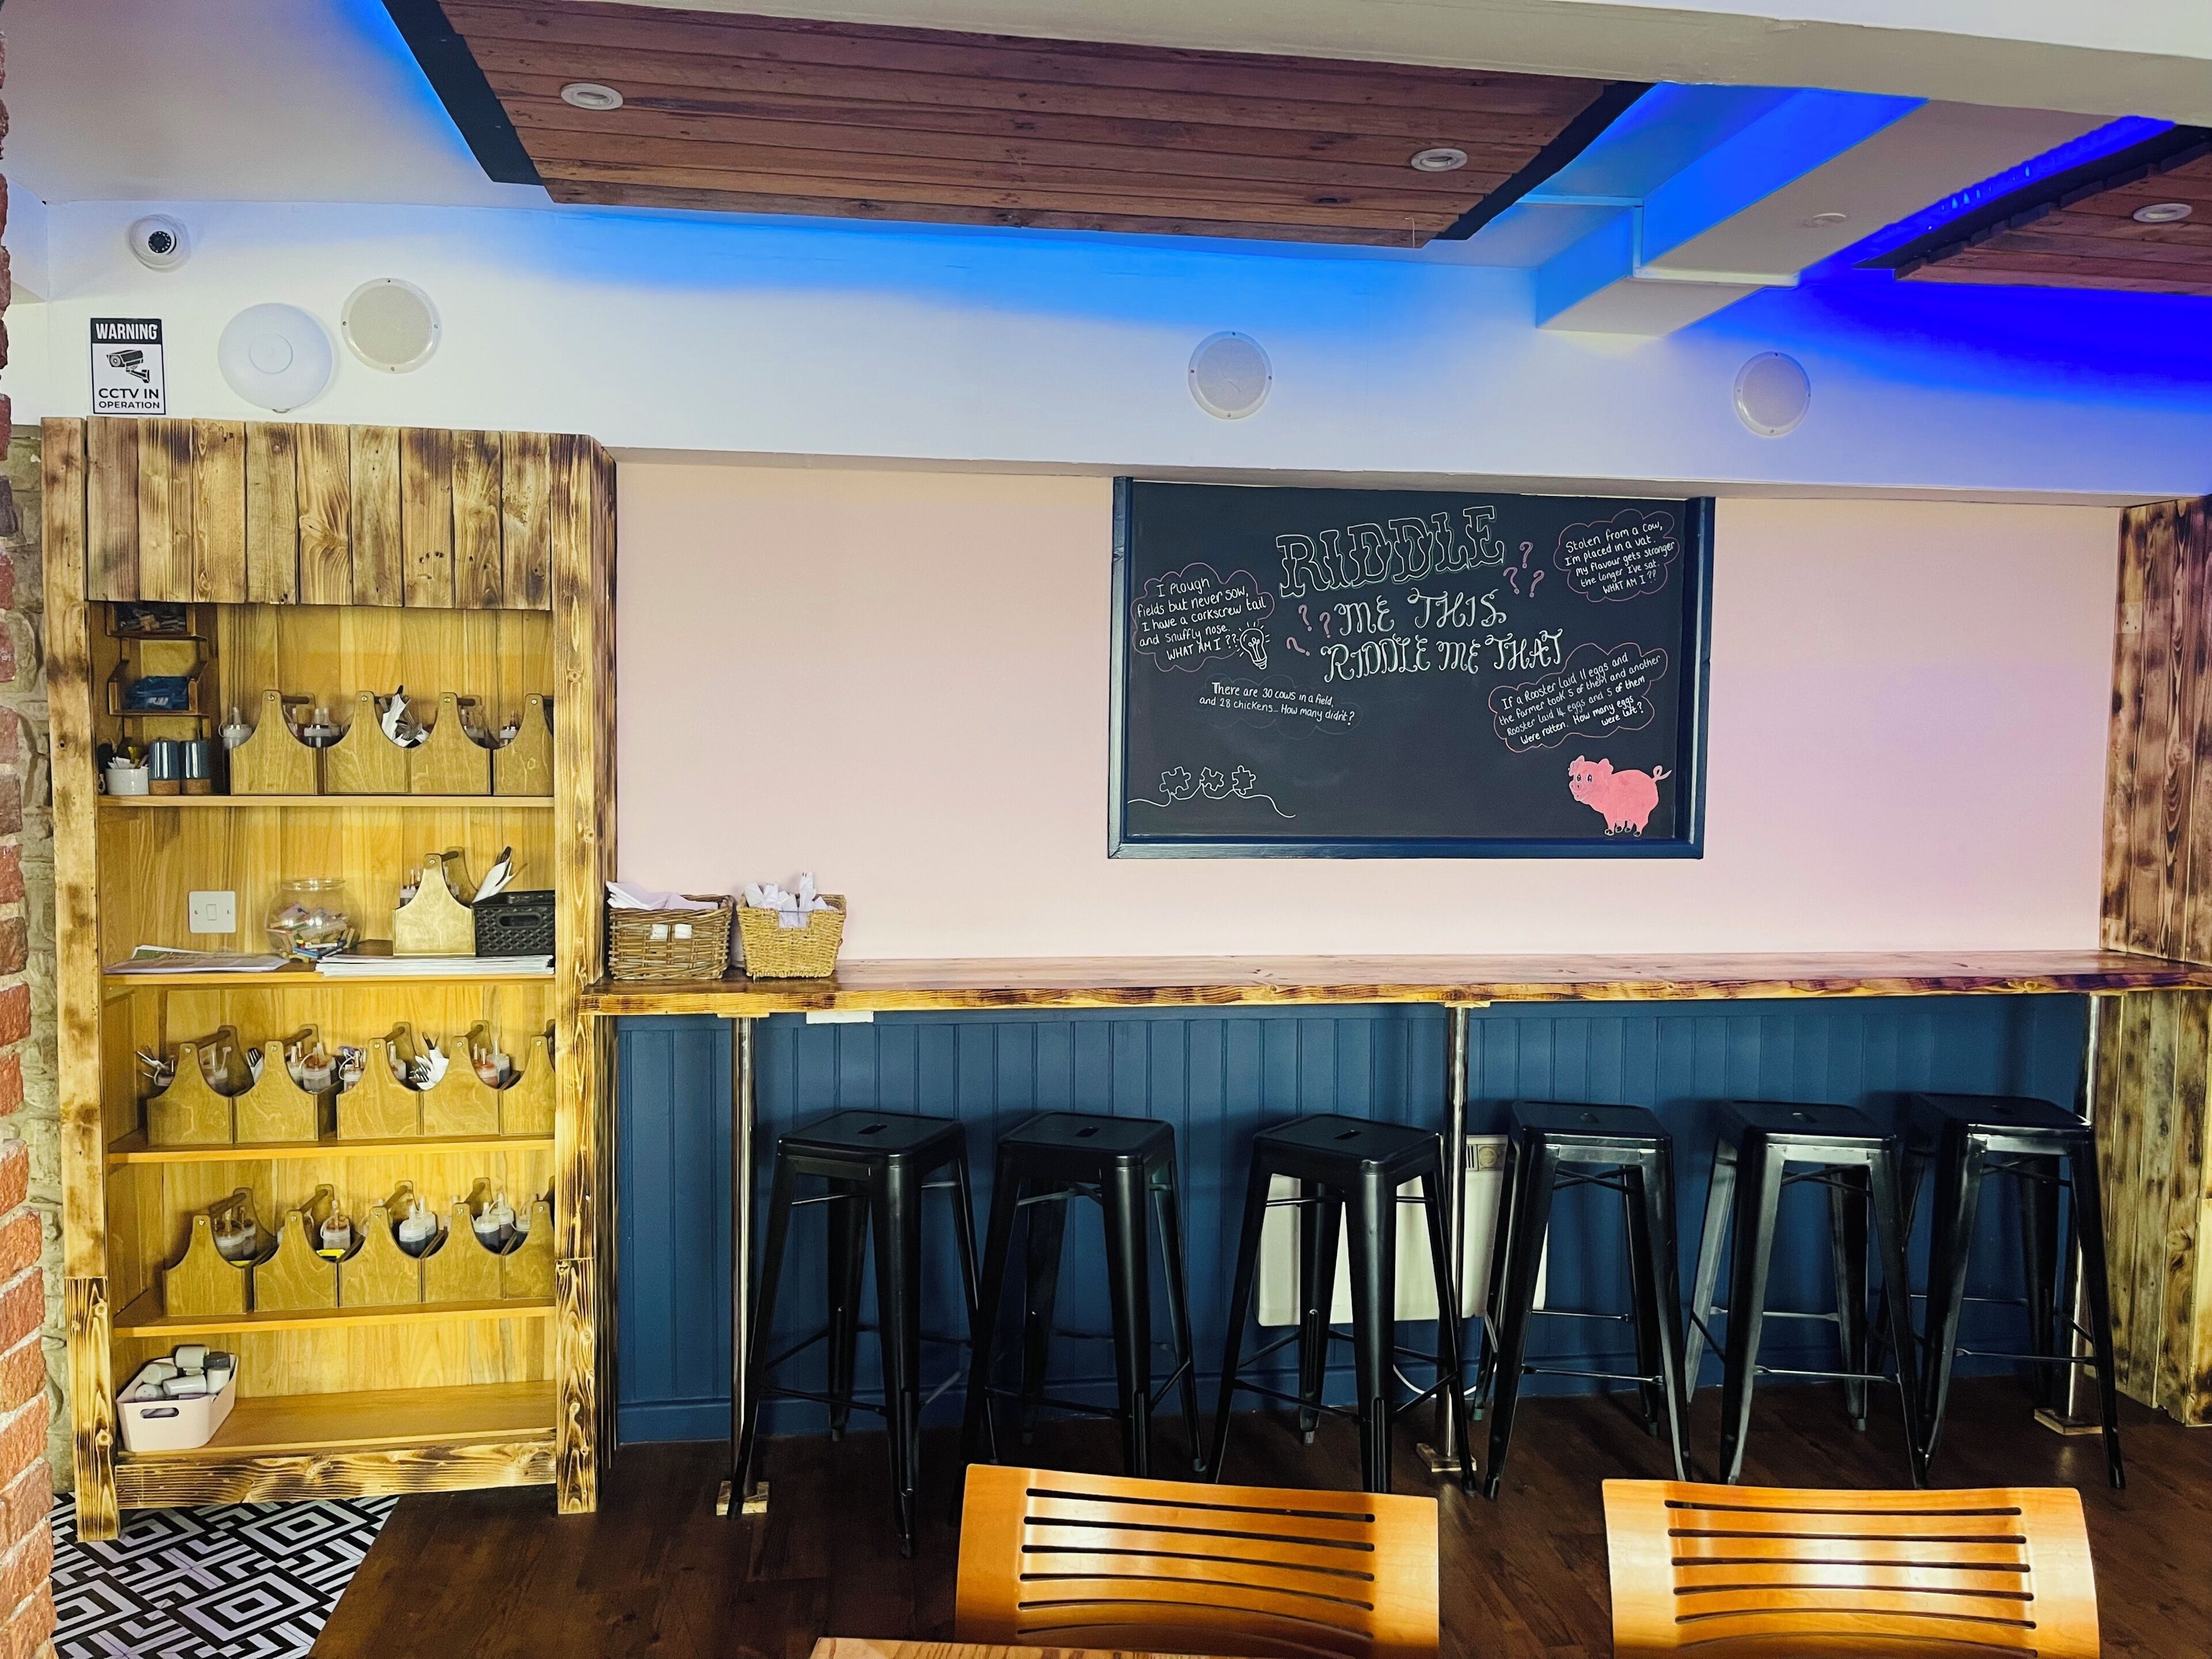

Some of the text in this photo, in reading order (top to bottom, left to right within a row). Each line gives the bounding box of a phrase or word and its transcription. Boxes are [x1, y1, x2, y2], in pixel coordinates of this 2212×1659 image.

[96, 324, 157, 340] WARNING
[99, 388, 158, 399] CCTV IN
[1277, 505, 1504, 597] RIDDLE
[1566, 536, 1600, 553] Stolen
[1606, 529, 1629, 541] from
[1584, 543, 1611, 563] placed
[1576, 541, 1675, 579] my flavour gets stronger
[1581, 576, 1596, 587] the
[1599, 568, 1623, 583] longer
[1603, 580, 1623, 594] WHAT
[1626, 578, 1637, 588] AM
[1639, 575, 1646, 585] I
[1157, 584, 1165, 597] I
[1137, 603, 1165, 618] fields
[1168, 600, 1188, 612] but
[1191, 592, 1222, 608] never
[1142, 622, 1150, 632] I
[1153, 618, 1177, 630] have
[1191, 605, 1241, 622] corkscrew
[1246, 596, 1266, 611] tail
[1334, 587, 1507, 636] ME THIS
[1139, 634, 1160, 646] and
[1165, 628, 1202, 645] snuffly
[1166, 644, 1194, 661] WHAT
[1198, 642, 1211, 653] AM
[1214, 638, 1221, 650] I
[1321, 628, 1563, 683] RIDDLE ME THAT
[1212, 683, 1240, 696] There
[1243, 688, 1257, 696] are
[1262, 688, 1272, 698] 30
[1274, 690, 1296, 700] cows
[1499, 714, 1514, 726] the
[1516, 702, 1544, 718] farmer
[1569, 690, 1574, 698] 5
[1577, 684, 1584, 695] of
[1586, 677, 1607, 691] them
[1610, 668, 1626, 681] and
[1629, 656, 1661, 675] another
[1501, 696, 1513, 710] If
[1517, 696, 1523, 704] a
[1525, 683, 1556, 702] Rooster
[1559, 672, 1577, 688] laid
[1589, 662, 1608, 680] eggs
[1612, 652, 1628, 667] and
[1199, 696, 1215, 706] and
[1219, 698, 1230, 708] 28
[1281, 704, 1297, 715] How
[1300, 707, 1322, 722] many
[1507, 719, 1535, 736] Rooster
[1538, 710, 1554, 723] laid
[1567, 699, 1585, 714] eggs
[1589, 693, 1604, 704] and
[1607, 688, 1612, 696] 5
[1615, 683, 1622, 693] of
[1624, 676, 1645, 690] them
[1573, 711, 1590, 725] How
[1592, 704, 1615, 717] many
[1617, 695, 1634, 709] eggs
[1601, 714, 1620, 726] were
